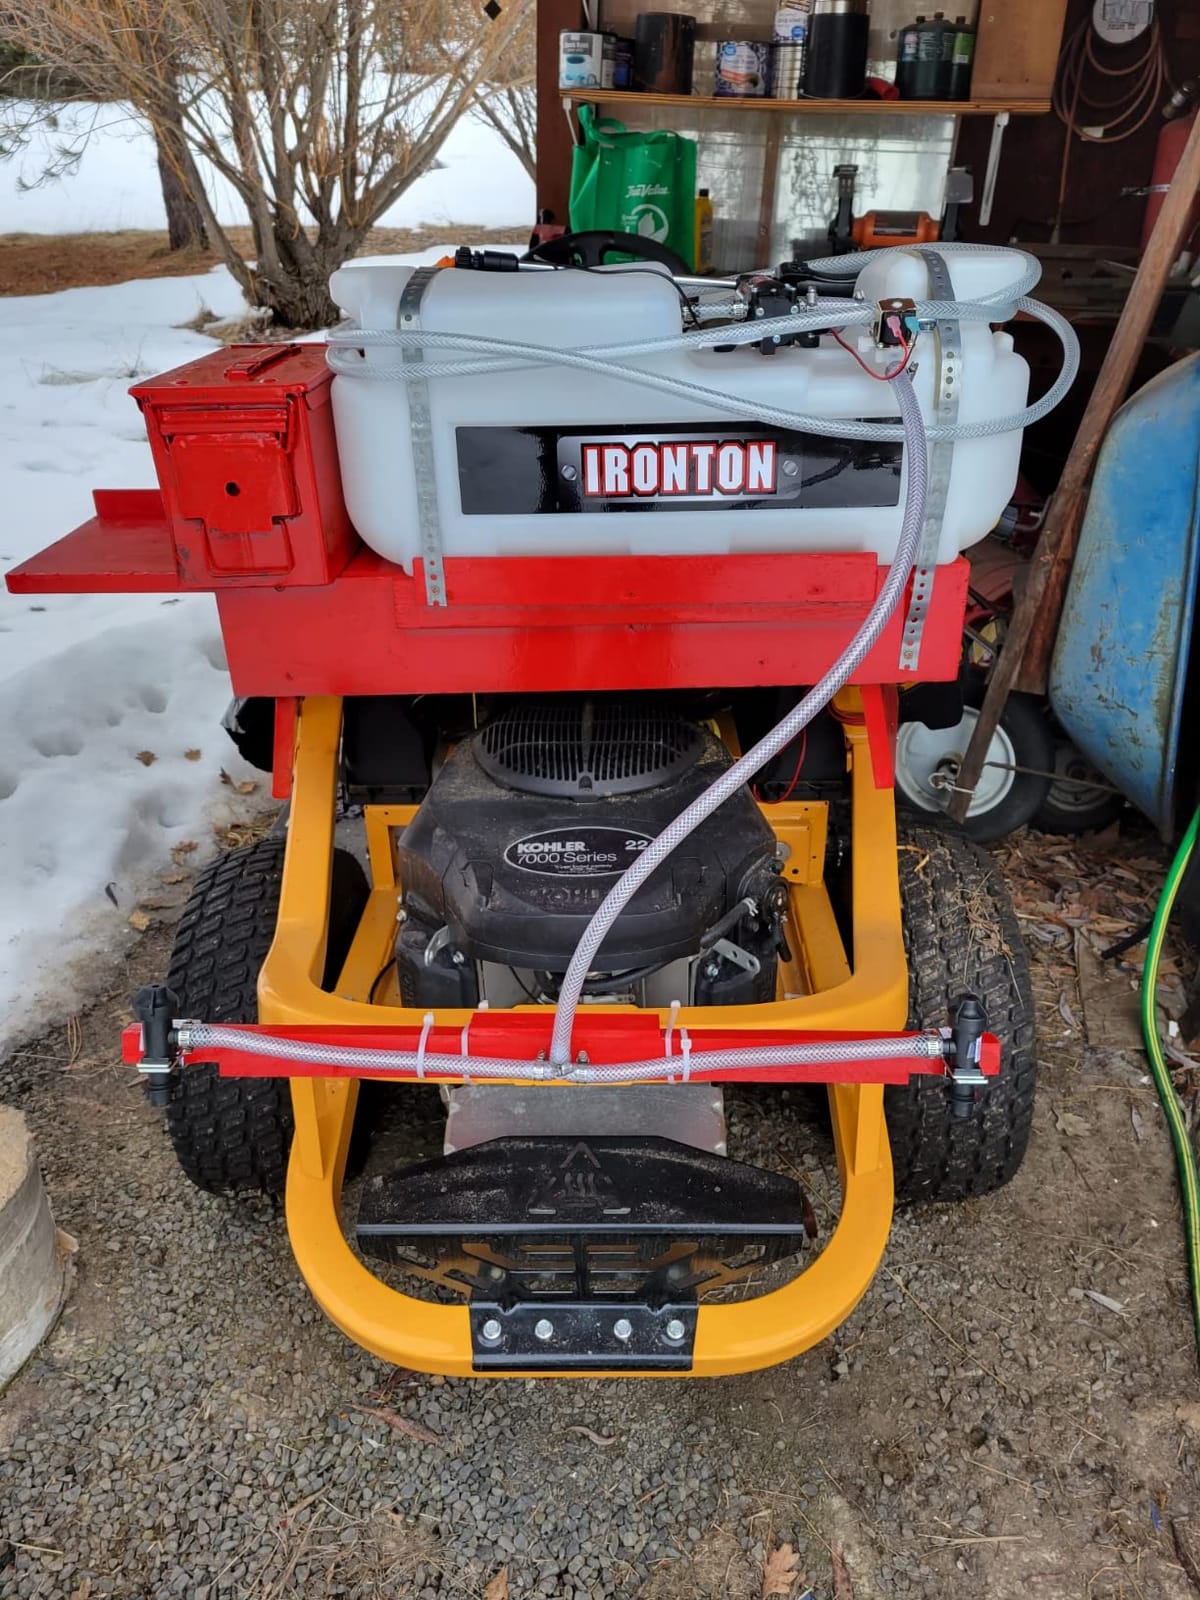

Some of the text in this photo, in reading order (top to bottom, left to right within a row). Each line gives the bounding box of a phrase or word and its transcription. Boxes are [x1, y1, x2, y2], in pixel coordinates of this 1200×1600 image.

[582, 441, 776, 495] IRONTON
[517, 841, 586, 854] KOHLER
[517, 851, 617, 864] 7000 Series
